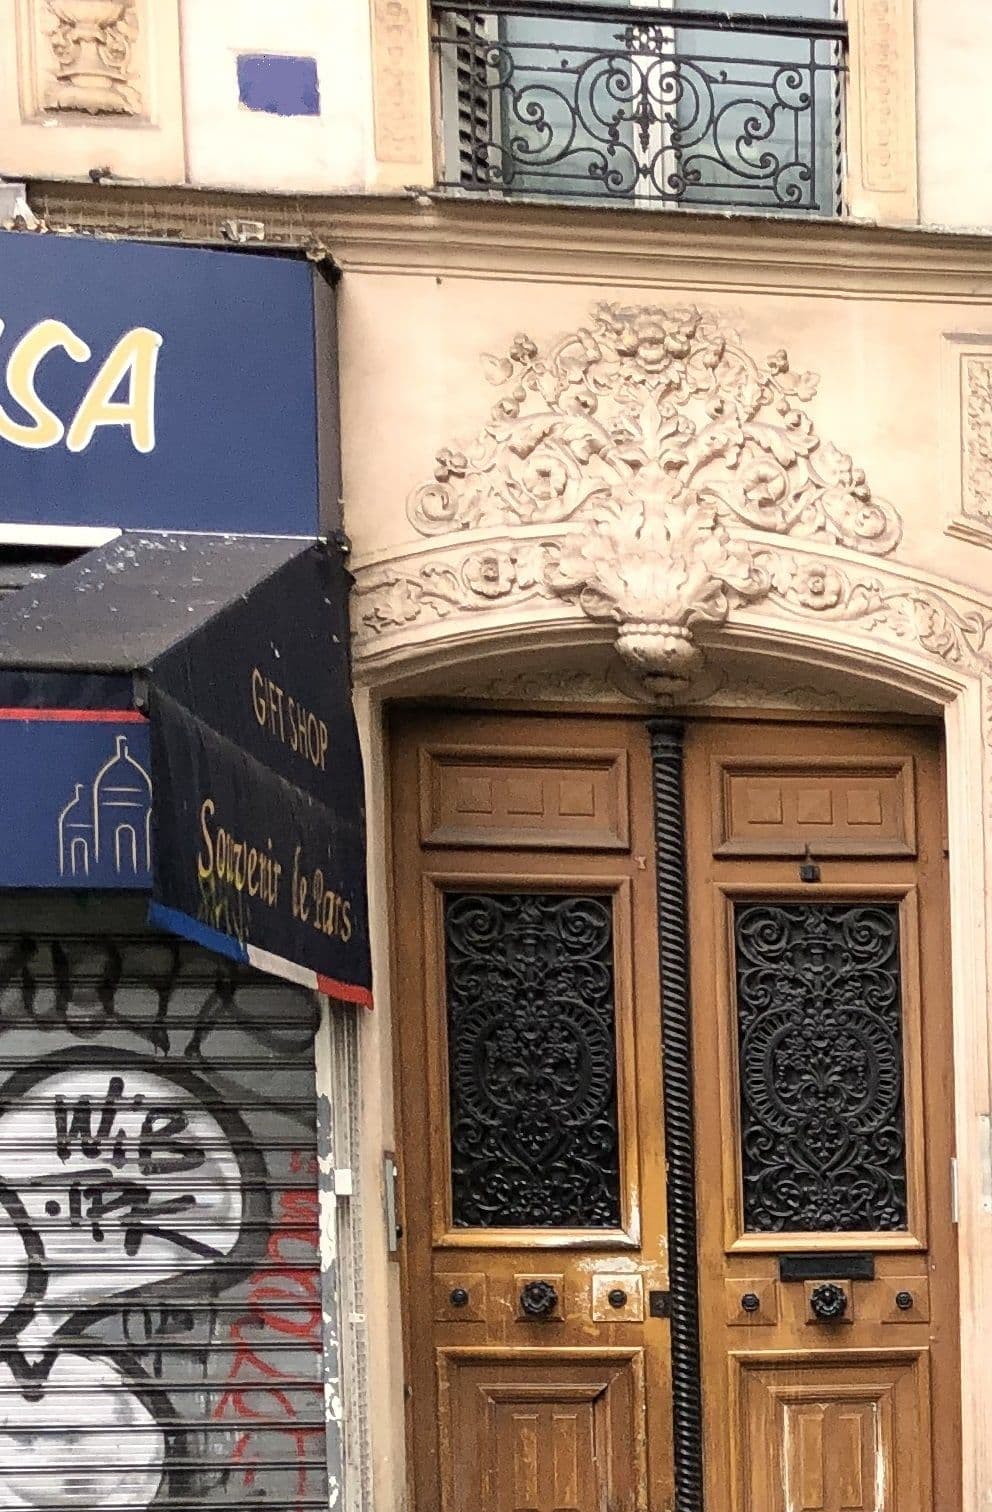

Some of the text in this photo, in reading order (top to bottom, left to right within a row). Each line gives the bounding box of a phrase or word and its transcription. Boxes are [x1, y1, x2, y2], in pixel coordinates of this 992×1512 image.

[0, 319, 163, 452] SA
[252, 667, 328, 771] GIFT SHOP
[198, 798, 281, 908] Souvenir
